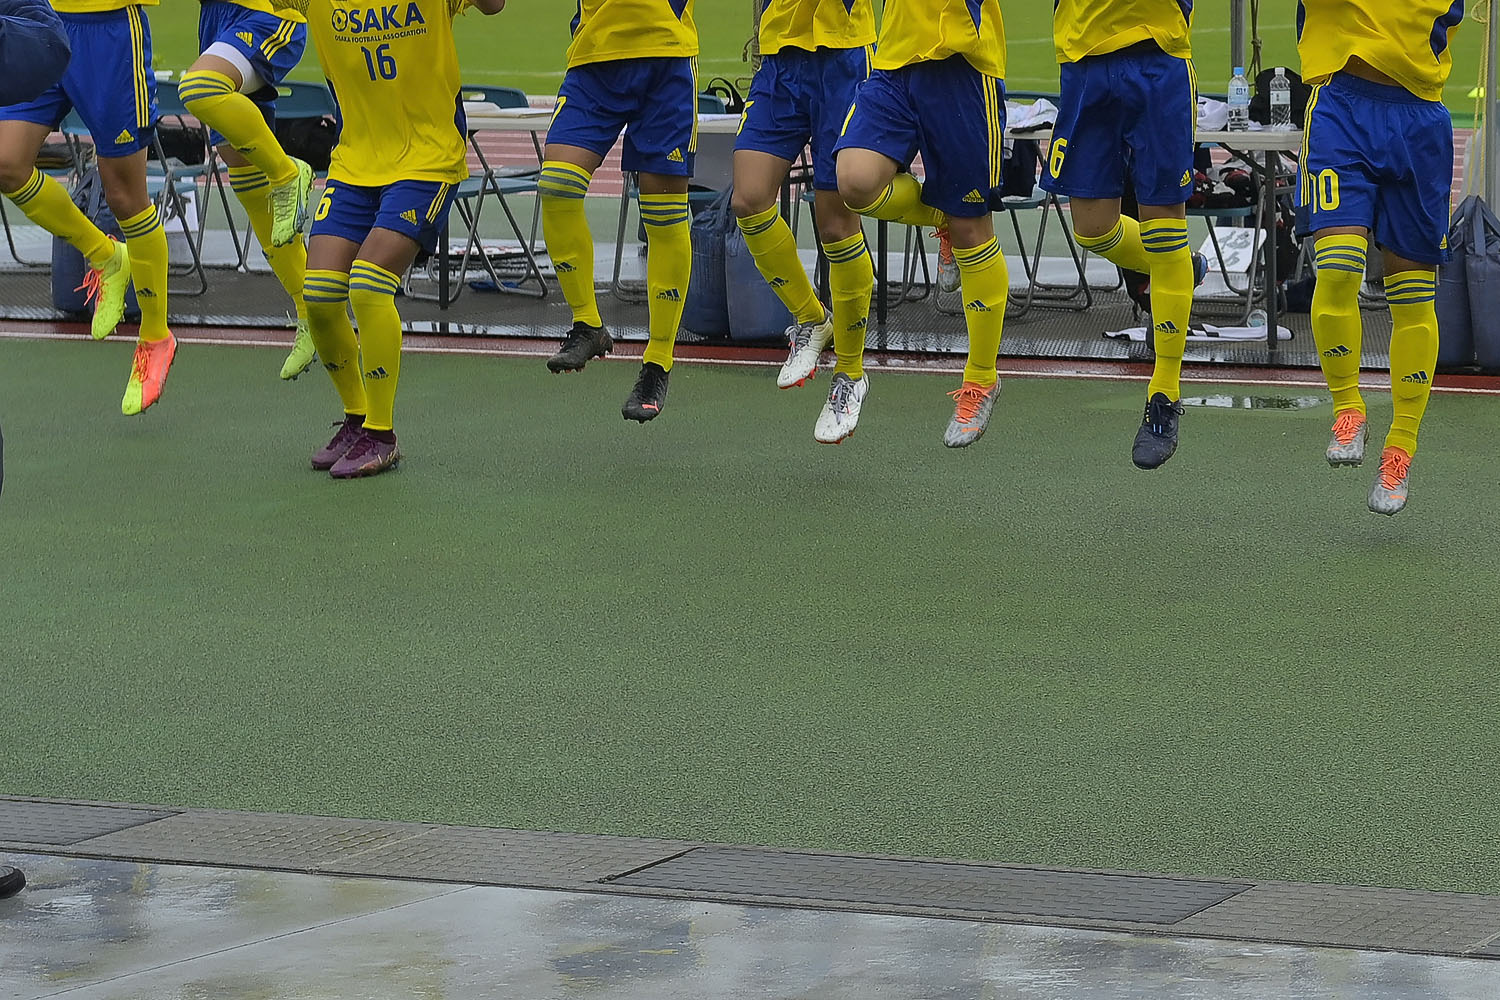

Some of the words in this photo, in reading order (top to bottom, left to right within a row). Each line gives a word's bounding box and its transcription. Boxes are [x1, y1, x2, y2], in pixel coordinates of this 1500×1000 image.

[331, 2, 426, 34] OSAKA
[361, 35, 391, 43] FOOTBALL
[392, 28, 427, 41] ASSOCIATION
[360, 43, 398, 82] 16
[1050, 137, 1068, 179] 6
[1310, 168, 1341, 214] 10
